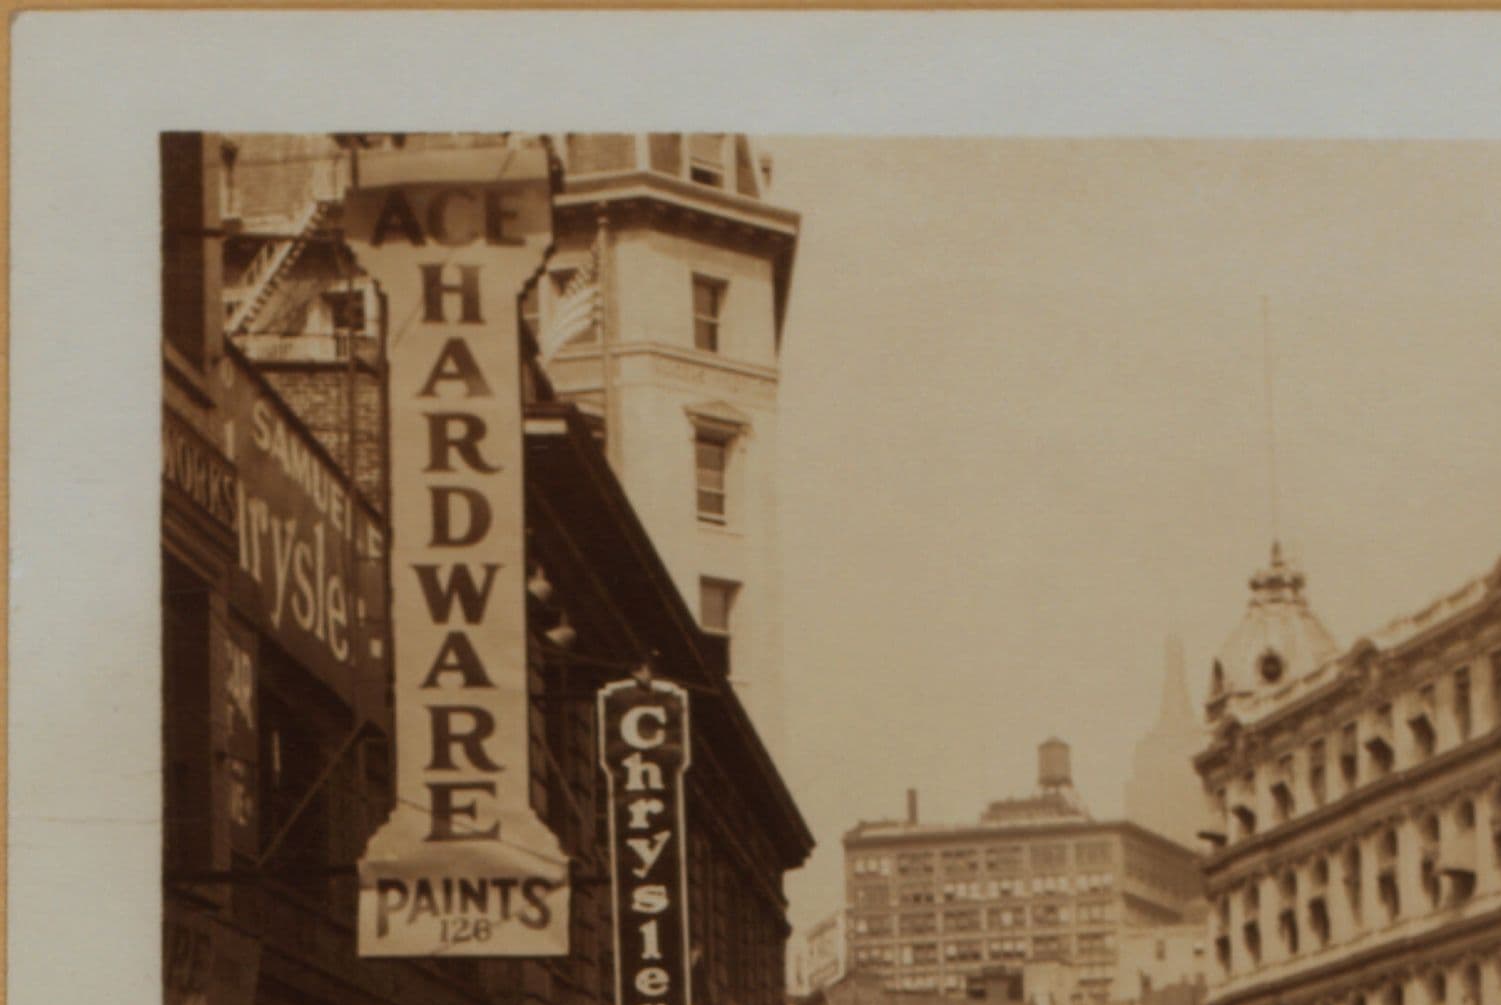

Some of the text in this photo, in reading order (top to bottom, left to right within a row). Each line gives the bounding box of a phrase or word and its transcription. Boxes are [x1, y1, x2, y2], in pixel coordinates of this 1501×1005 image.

[371, 187, 527, 247] ACE
[411, 262, 505, 843] HARDWARE
[375, 875, 567, 939] PAINTS
